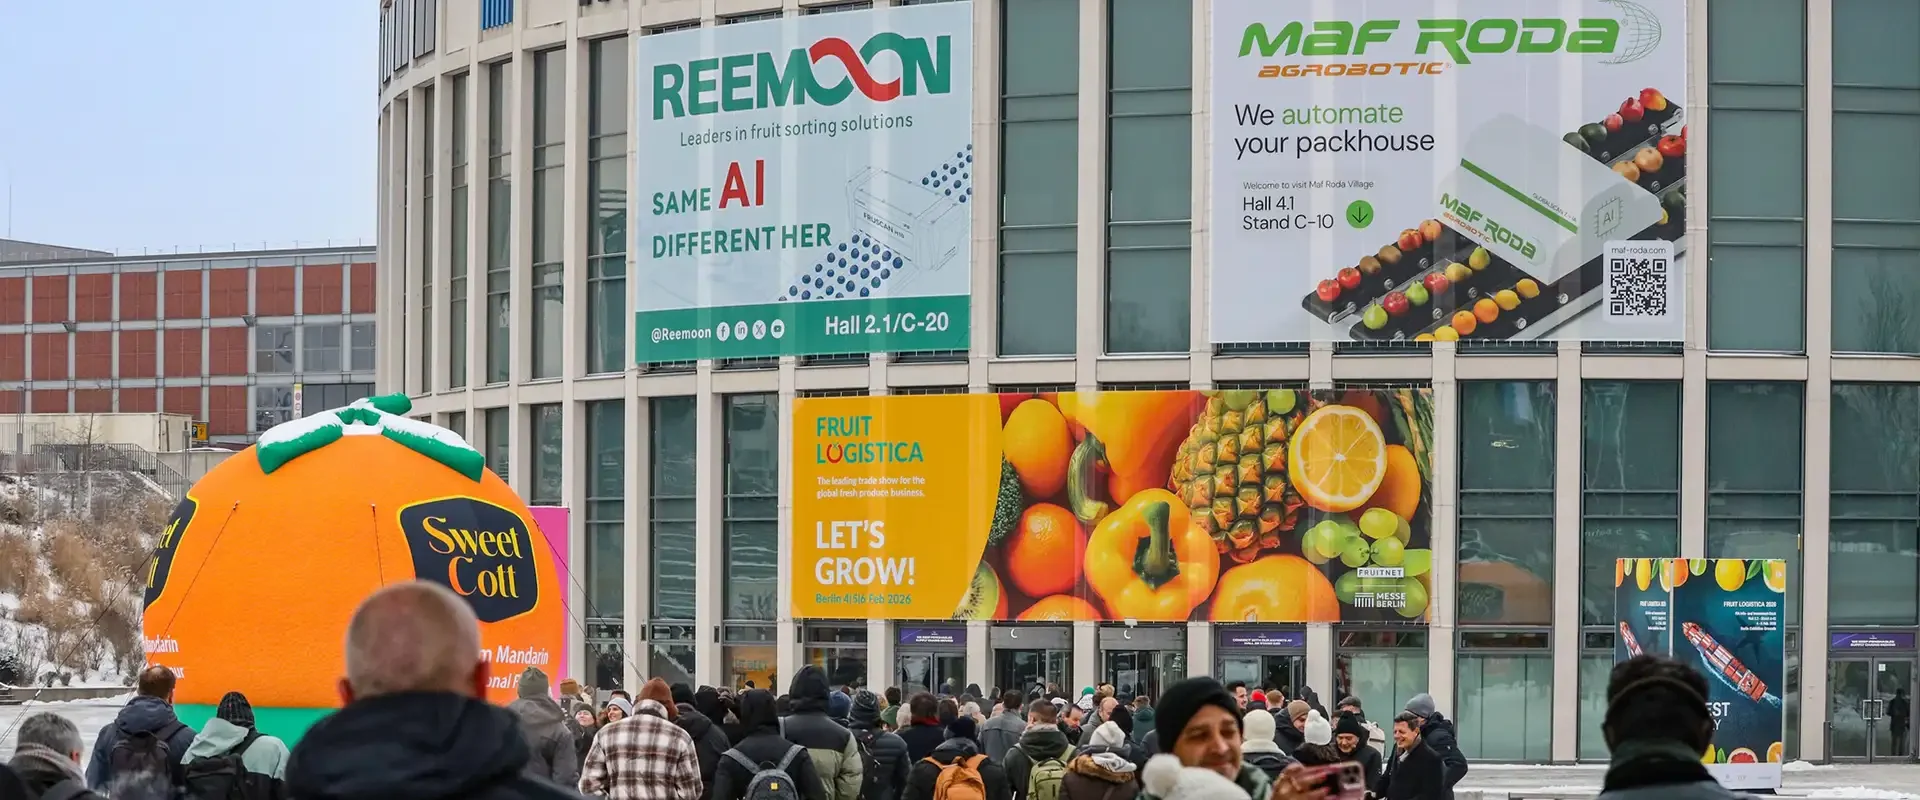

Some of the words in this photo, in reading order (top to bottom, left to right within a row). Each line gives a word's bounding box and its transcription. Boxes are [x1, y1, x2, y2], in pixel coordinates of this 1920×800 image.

[653, 32, 951, 120] REEMOON
[1235, 104, 1274, 126] We
[1282, 103, 1404, 125] automate
[680, 126, 732, 146] Leaders
[735, 125, 747, 141] in
[751, 121, 782, 140] fruit
[785, 118, 837, 138] sorting
[841, 113, 913, 132] solutions
[1234, 136, 1289, 160] your
[1297, 129, 1435, 159] packhouse
[652, 187, 711, 216] SAME
[718, 160, 765, 209] AI
[1243, 181, 1280, 190] Welcome
[1281, 181, 1290, 190] to
[1291, 181, 1307, 189] visit
[1309, 180, 1324, 189] Maf
[1325, 180, 1346, 189] Roda
[1347, 180, 1374, 190] Village
[1243, 196, 1271, 211] Hall
[1276, 196, 1295, 211] 4.1
[1242, 215, 1291, 230] Stand
[1295, 214, 1334, 229] C-10
[652, 226, 775, 259] DIFFERENT
[782, 223, 832, 249] HER
[1611, 246, 1667, 254] maf-roda.com
[651, 326, 712, 343] @Reemoon
[825, 313, 860, 335] Hall
[865, 312, 949, 334] 2.1/C-20
[816, 416, 872, 437] FRUIT
[816, 441, 924, 464] LOGISTICA
[817, 476, 831, 485] The
[831, 476, 857, 486] leading
[858, 476, 877, 485] trade
[879, 476, 897, 485] show
[899, 476, 911, 484] for
[912, 476, 925, 484] the
[817, 489, 838, 499] global
[840, 489, 858, 498] fresh
[859, 489, 888, 499] produce
[890, 488, 925, 497] business.
[422, 516, 523, 559] Sweet
[816, 519, 885, 549] LET'S
[448, 555, 520, 599] Cott
[815, 557, 915, 585] GROW!
[816, 593, 842, 604] Berlin
[868, 593, 885, 604] Feb
[888, 594, 911, 604] 2026
[1376, 592, 1406, 600] MESSE
[1376, 600, 1406, 608] BERLIN
[496, 645, 549, 665] Mandarin
